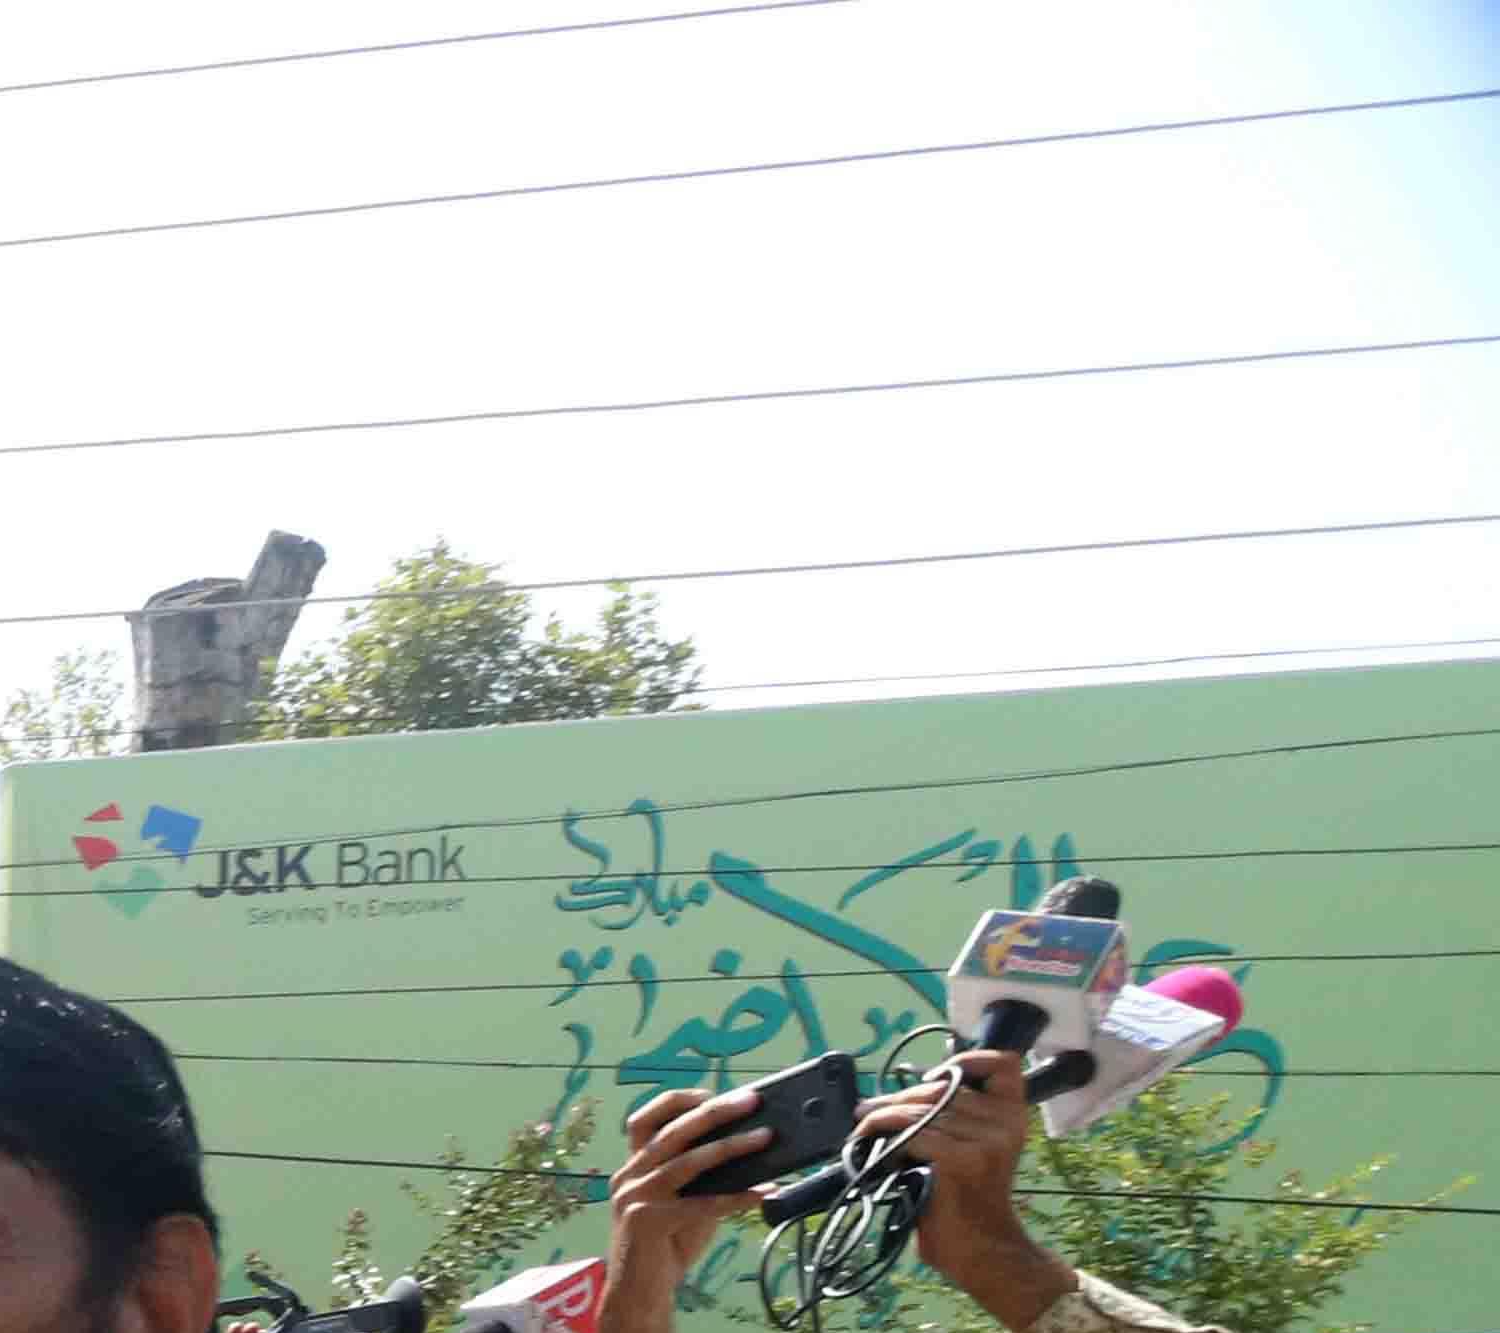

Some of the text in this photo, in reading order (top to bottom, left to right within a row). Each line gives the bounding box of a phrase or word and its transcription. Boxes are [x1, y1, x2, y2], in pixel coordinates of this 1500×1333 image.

[198, 834, 467, 898] J&K Bank
[247, 896, 466, 927] Serving To Empower
